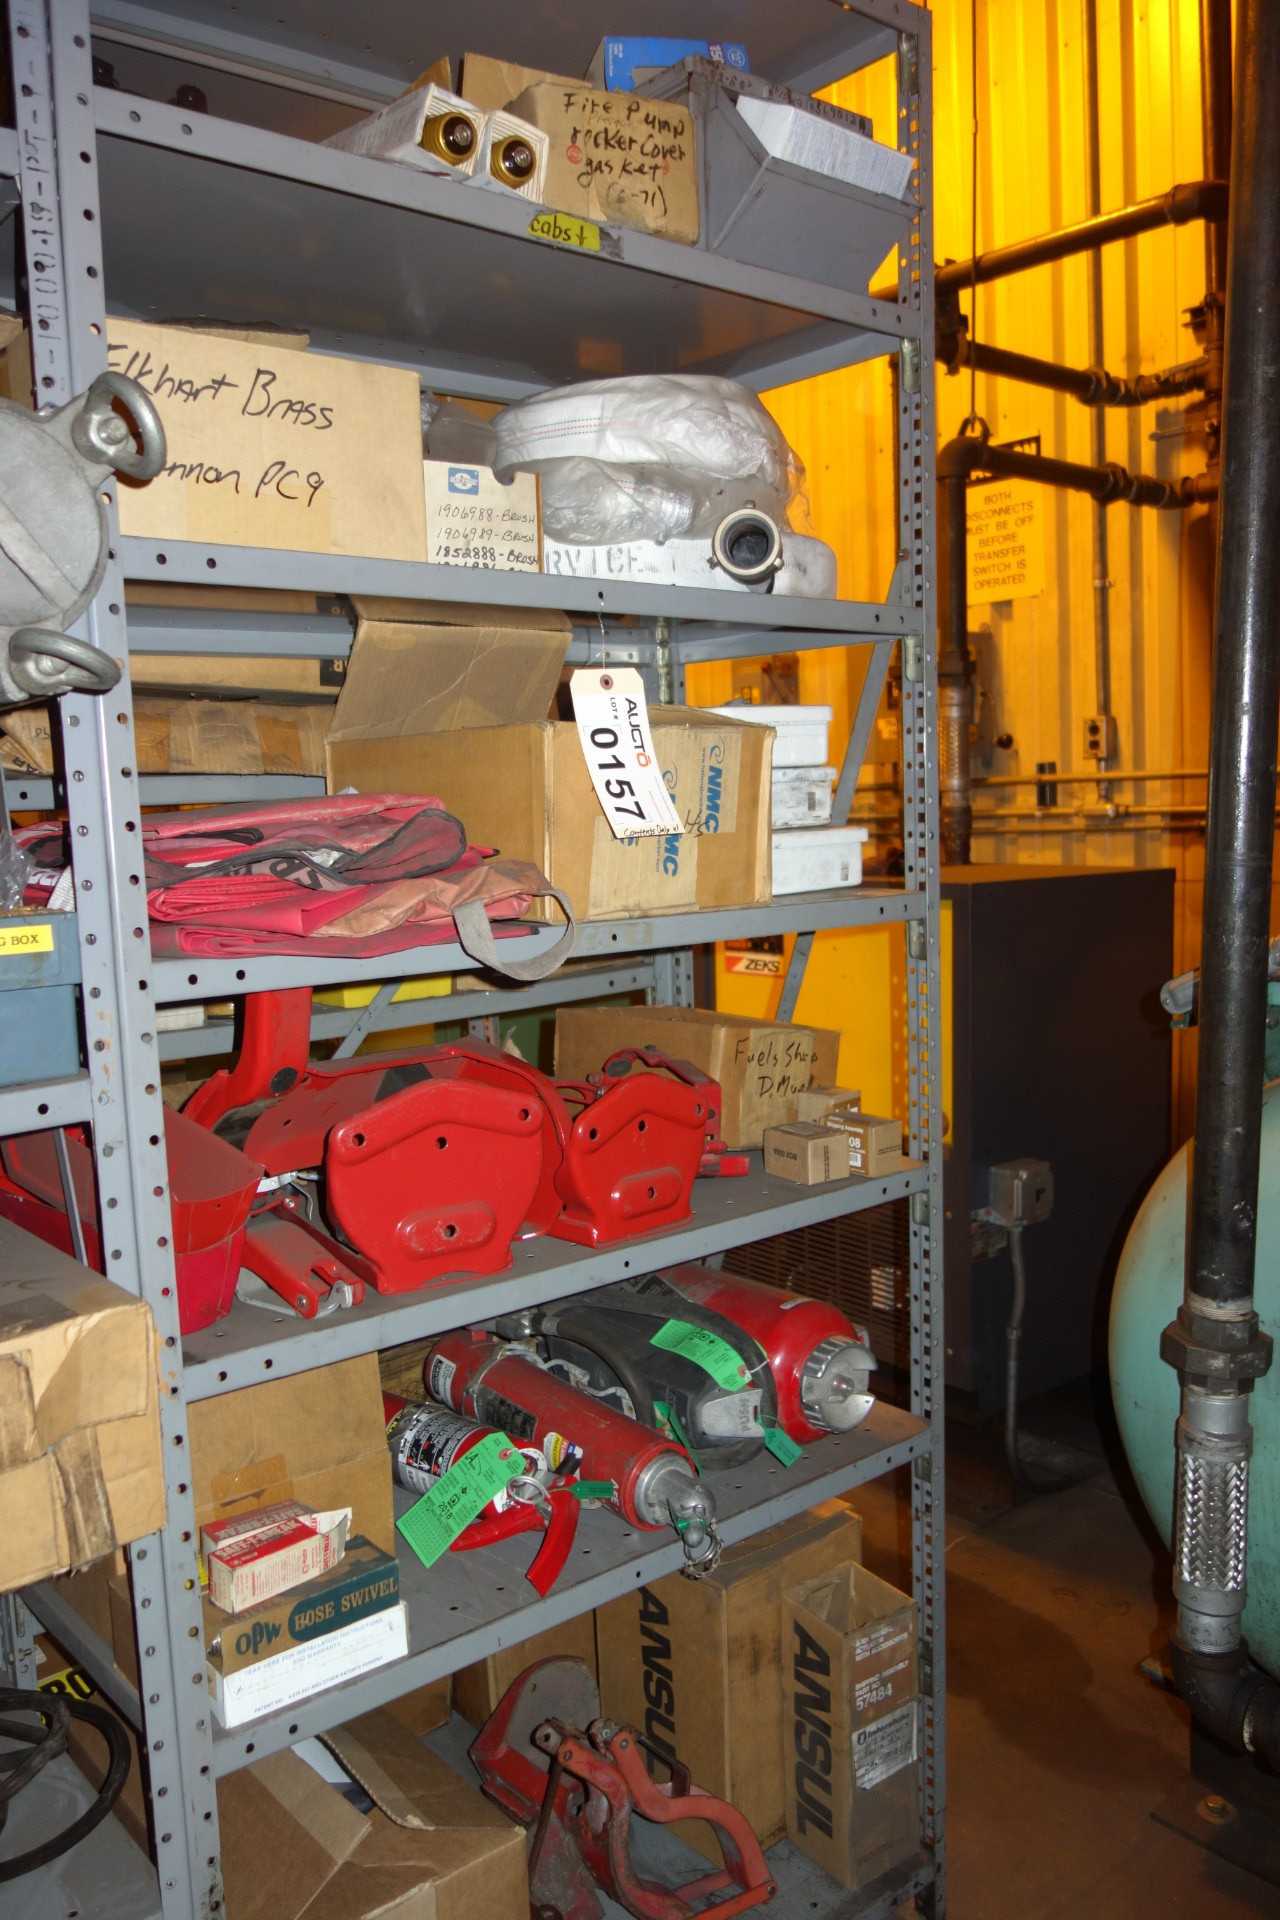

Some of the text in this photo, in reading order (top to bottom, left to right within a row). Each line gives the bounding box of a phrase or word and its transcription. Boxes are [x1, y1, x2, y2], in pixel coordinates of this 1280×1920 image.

[564, 93, 685, 138] Fire Pump
[640, 134, 686, 161] Cover
[577, 158, 661, 188] gasket
[255, 461, 325, 508] PC9
[984, 491, 1012, 505] BOTH
[996, 520, 1009, 532] BE
[1015, 515, 1034, 528] OFF
[974, 546, 1026, 561] TRANSFER
[979, 532, 1017, 548] BEFORE
[974, 559, 1027, 576] SWITCH IS
[974, 574, 1026, 590] OPERATED
[590, 727, 647, 821] 0157
[705, 766, 723, 833] NMC
[11, 934, 40, 945] BOX
[744, 959, 781, 972] ZEKS
[235, 1577, 398, 1656] OPW HOSE SWIVEL
[856, 1681, 892, 1711] 57484
[794, 1618, 833, 1839] ANSUL
